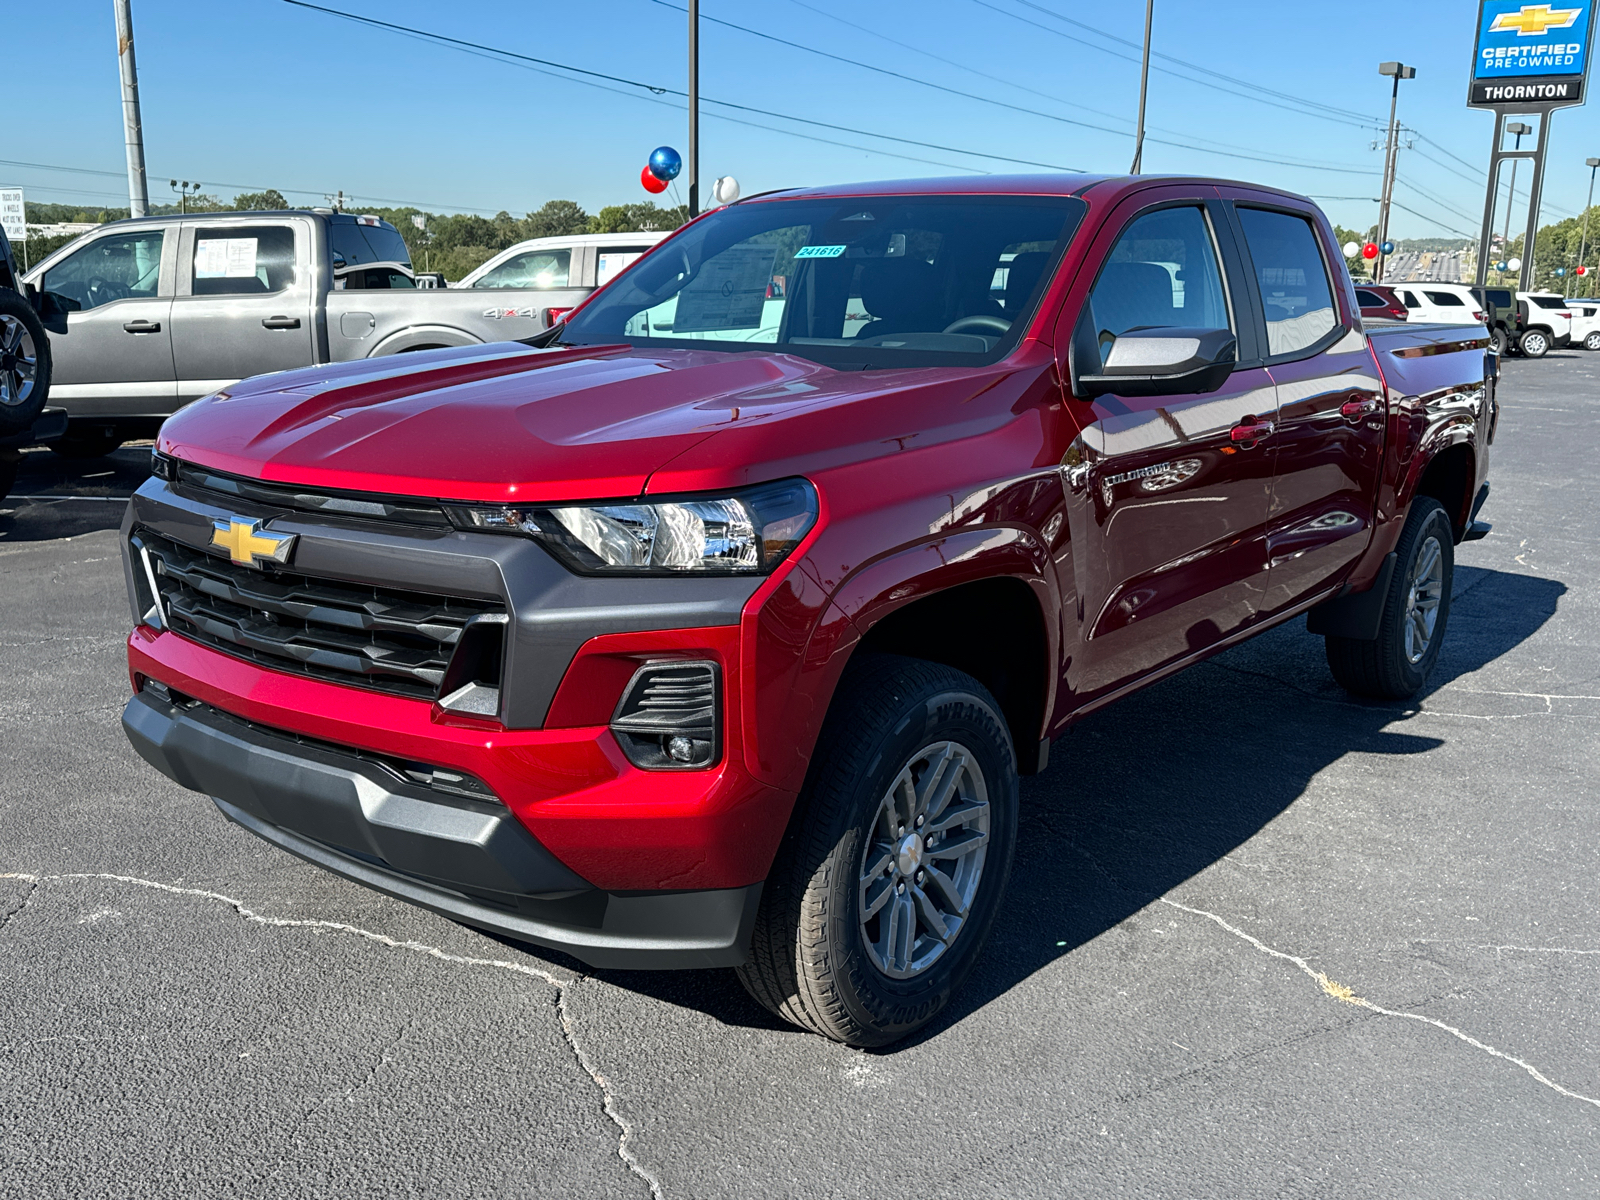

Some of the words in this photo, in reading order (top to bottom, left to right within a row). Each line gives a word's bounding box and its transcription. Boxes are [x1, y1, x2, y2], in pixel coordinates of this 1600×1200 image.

[1482, 43, 1580, 58] CERTIFIED
[1485, 55, 1574, 69] PRE-OWNED
[1484, 84, 1568, 99] THORNTON
[798, 246, 843, 256] 241616
[1104, 462, 1171, 486] COLORADO
[936, 701, 1012, 767] WRANGLER
[848, 966, 942, 1028] GOODYEAR
